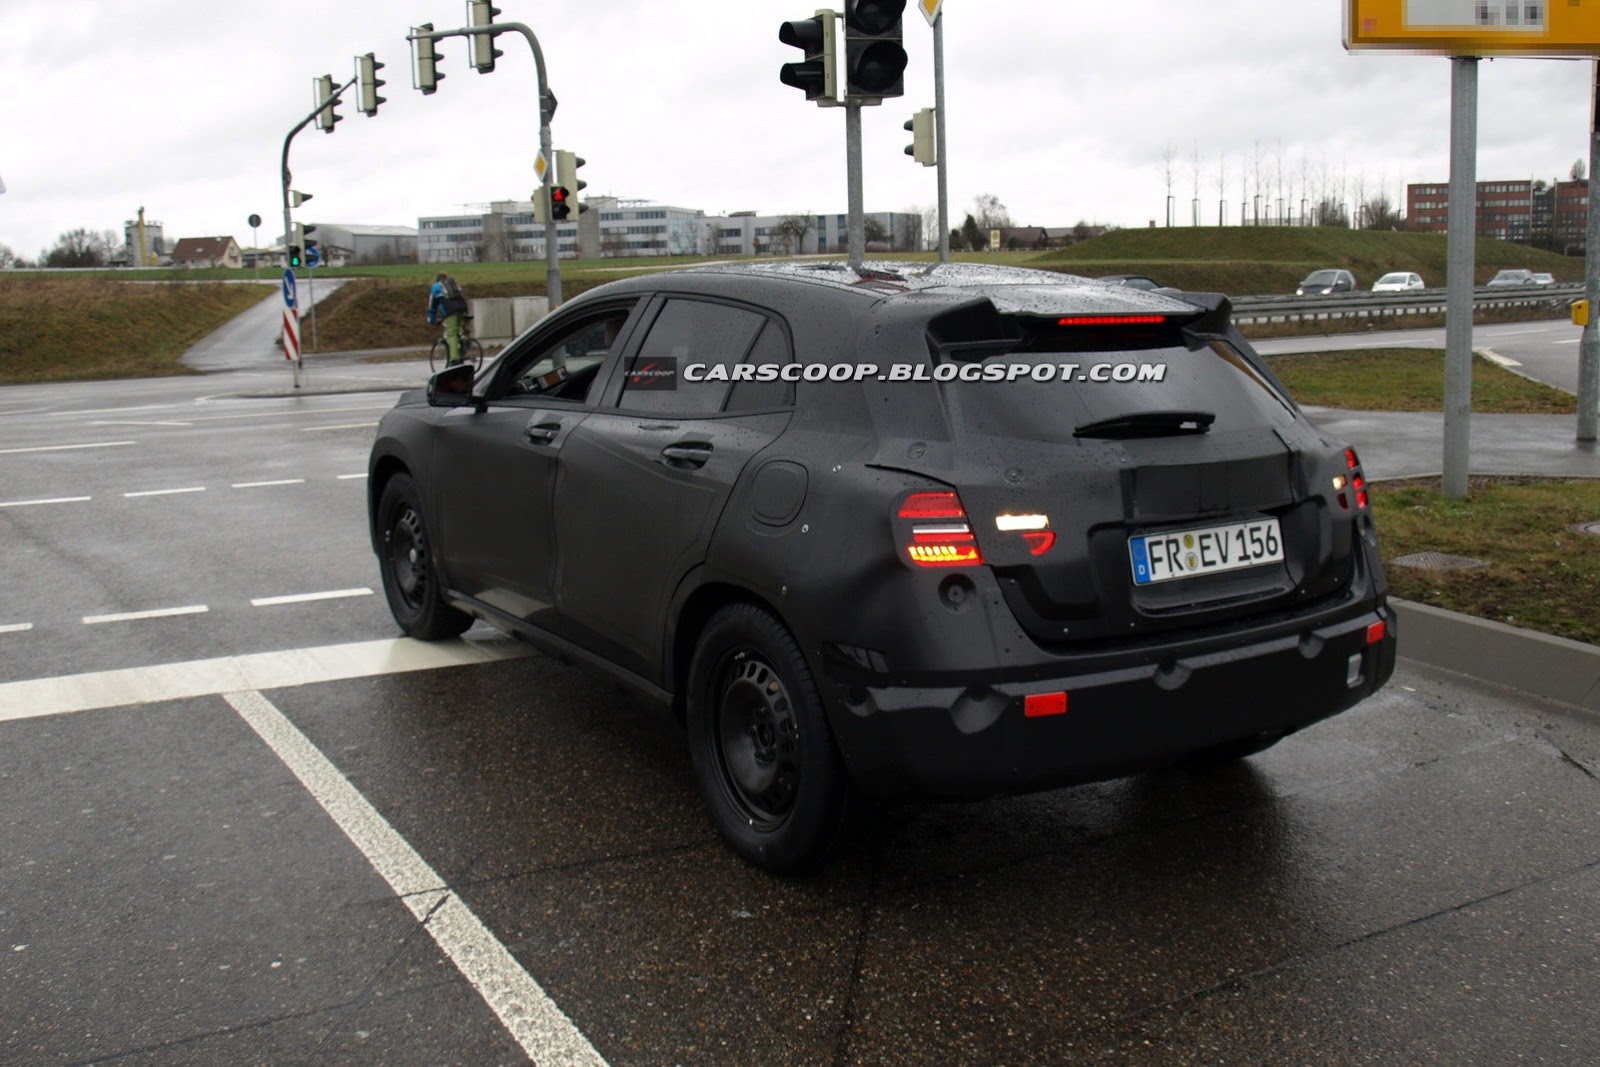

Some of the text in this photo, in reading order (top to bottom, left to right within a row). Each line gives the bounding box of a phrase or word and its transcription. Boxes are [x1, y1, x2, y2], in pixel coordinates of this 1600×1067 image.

[1148, 525, 1279, 575] FR EV 156
[1138, 565, 1146, 575] D
